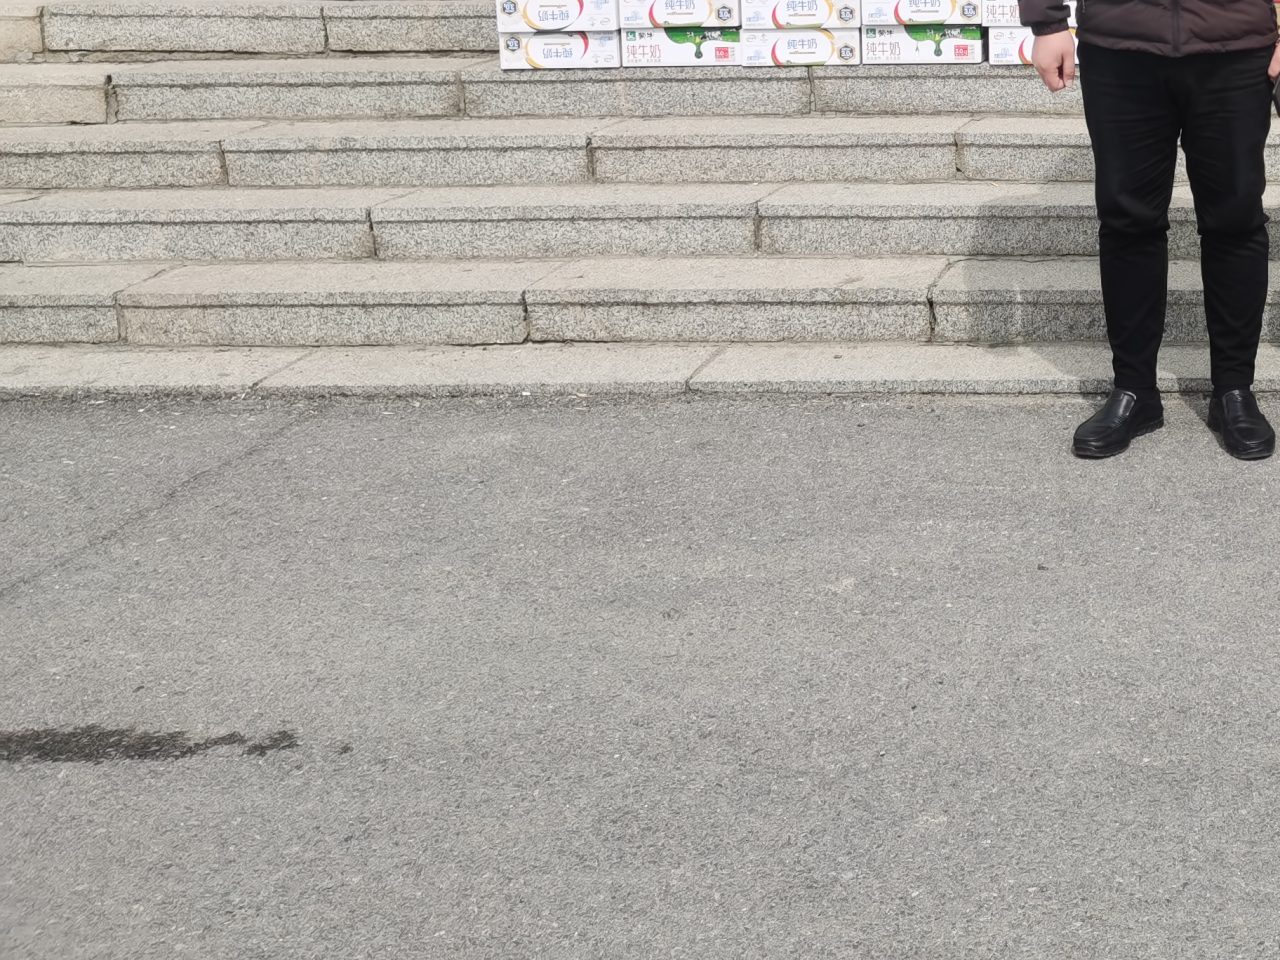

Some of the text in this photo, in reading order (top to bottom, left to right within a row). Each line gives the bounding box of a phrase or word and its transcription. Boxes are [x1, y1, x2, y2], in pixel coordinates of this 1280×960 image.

[664, 0, 695, 10] 纯牛奶
[786, 0, 818, 11] 纯牛奶
[787, 38, 818, 49] 纯牛奶
[866, 42, 900, 56] 纯牛奶
[626, 45, 662, 58] 纯牛奶
